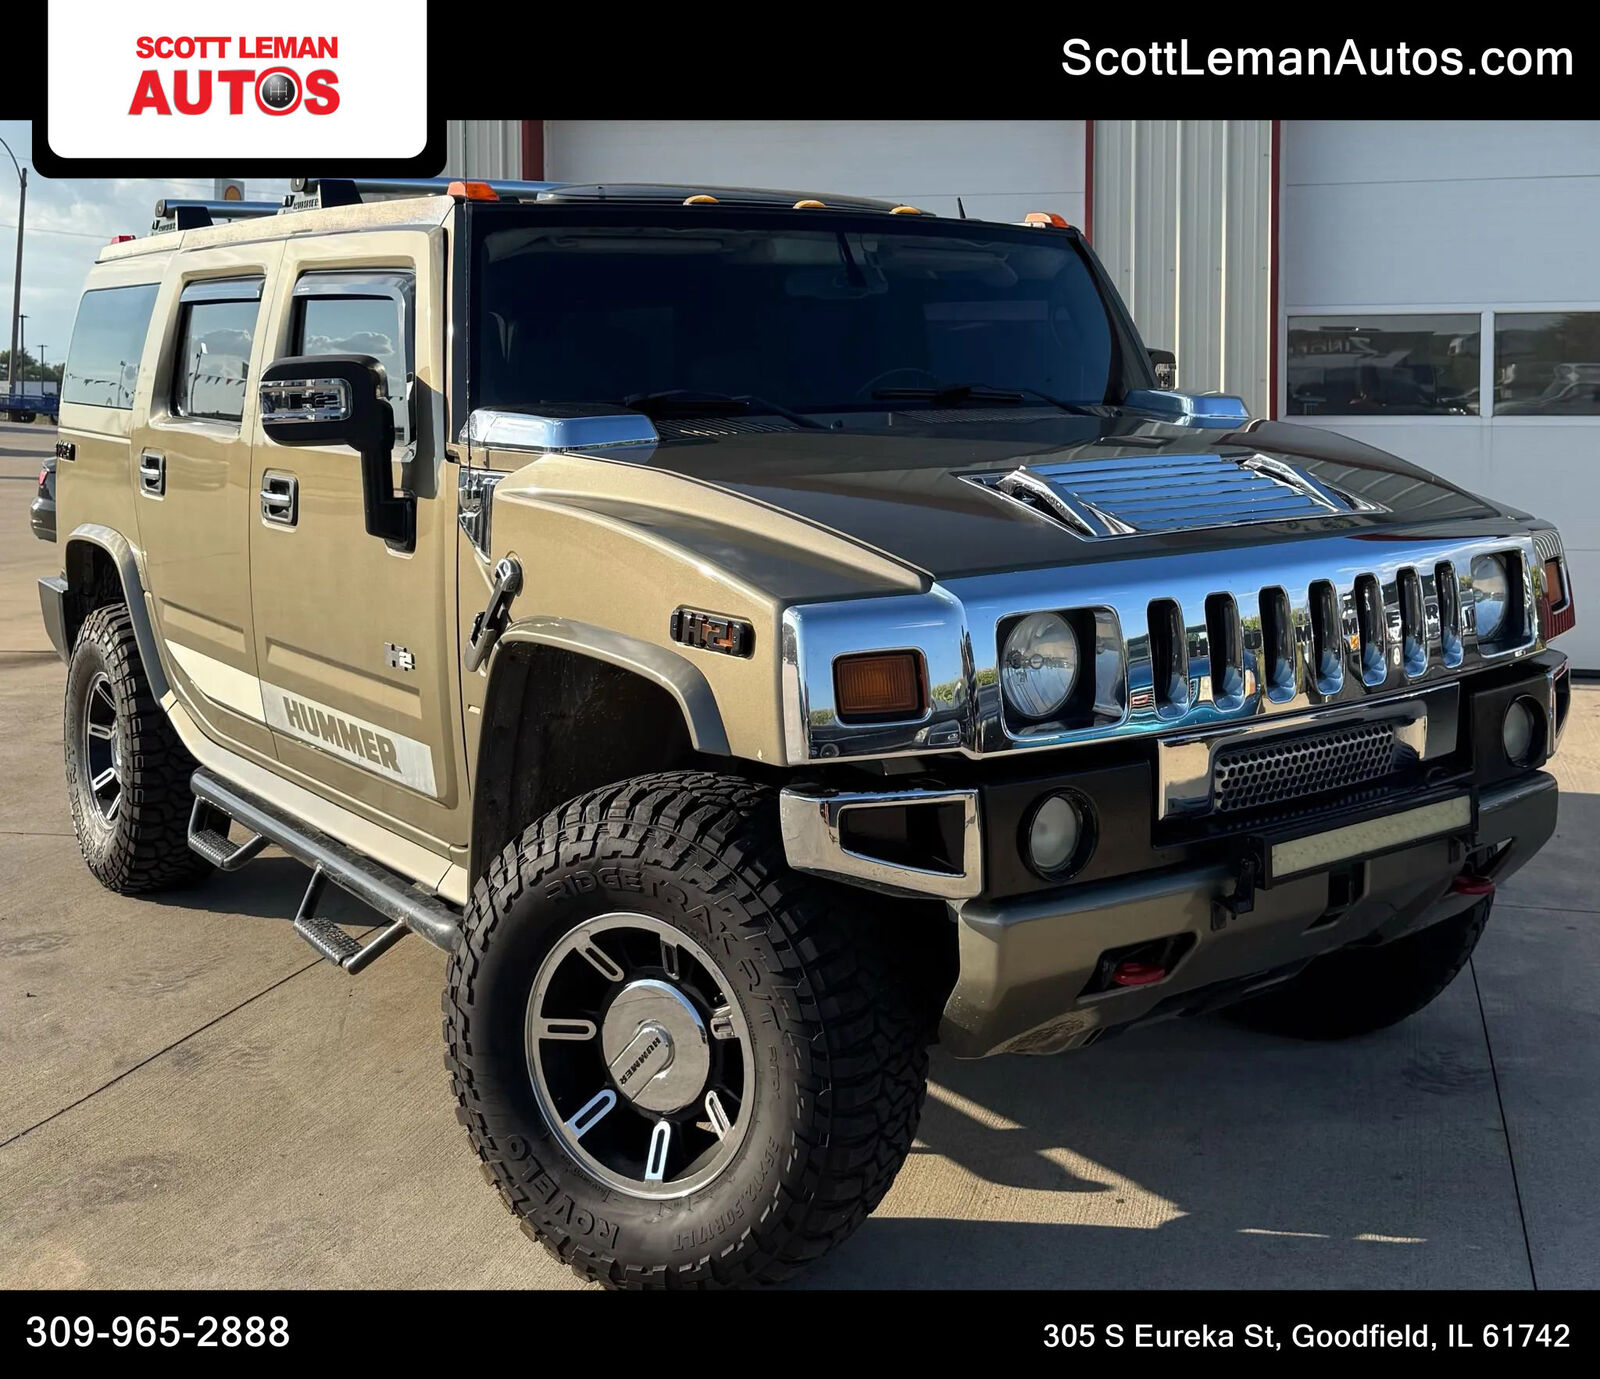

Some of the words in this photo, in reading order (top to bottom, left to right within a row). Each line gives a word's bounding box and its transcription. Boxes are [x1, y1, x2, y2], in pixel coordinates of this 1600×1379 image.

[384, 641, 415, 671] H2
[1187, 603, 1439, 658] HUMMER
[283, 696, 402, 774] HUMMER
[619, 1037, 661, 1085] HUMMER
[505, 1134, 620, 1249] ROVELO
